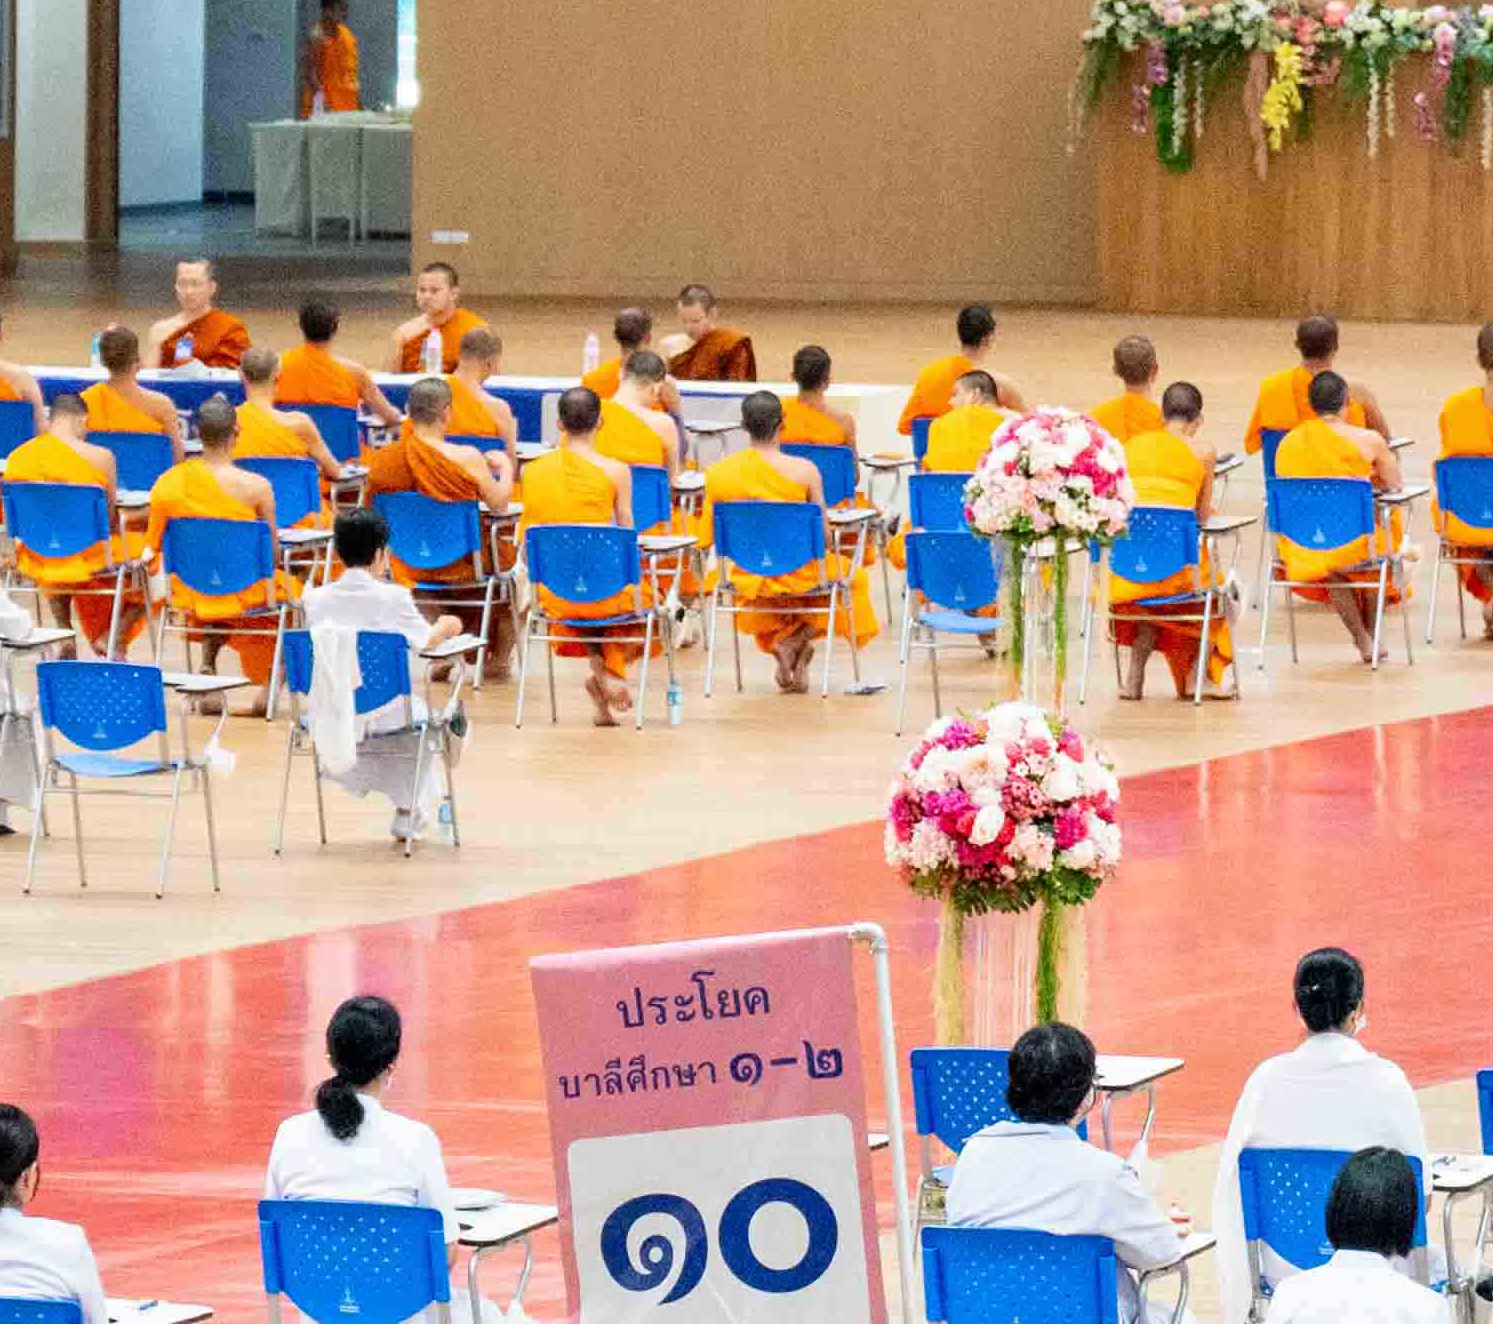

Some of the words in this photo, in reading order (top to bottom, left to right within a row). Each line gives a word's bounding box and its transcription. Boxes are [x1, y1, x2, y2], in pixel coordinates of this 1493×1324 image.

[616, 969, 771, 1028] ประโยค
[558, 1053, 717, 1099] บาลีศึกษา
[600, 1177, 839, 1306] ๑๐
